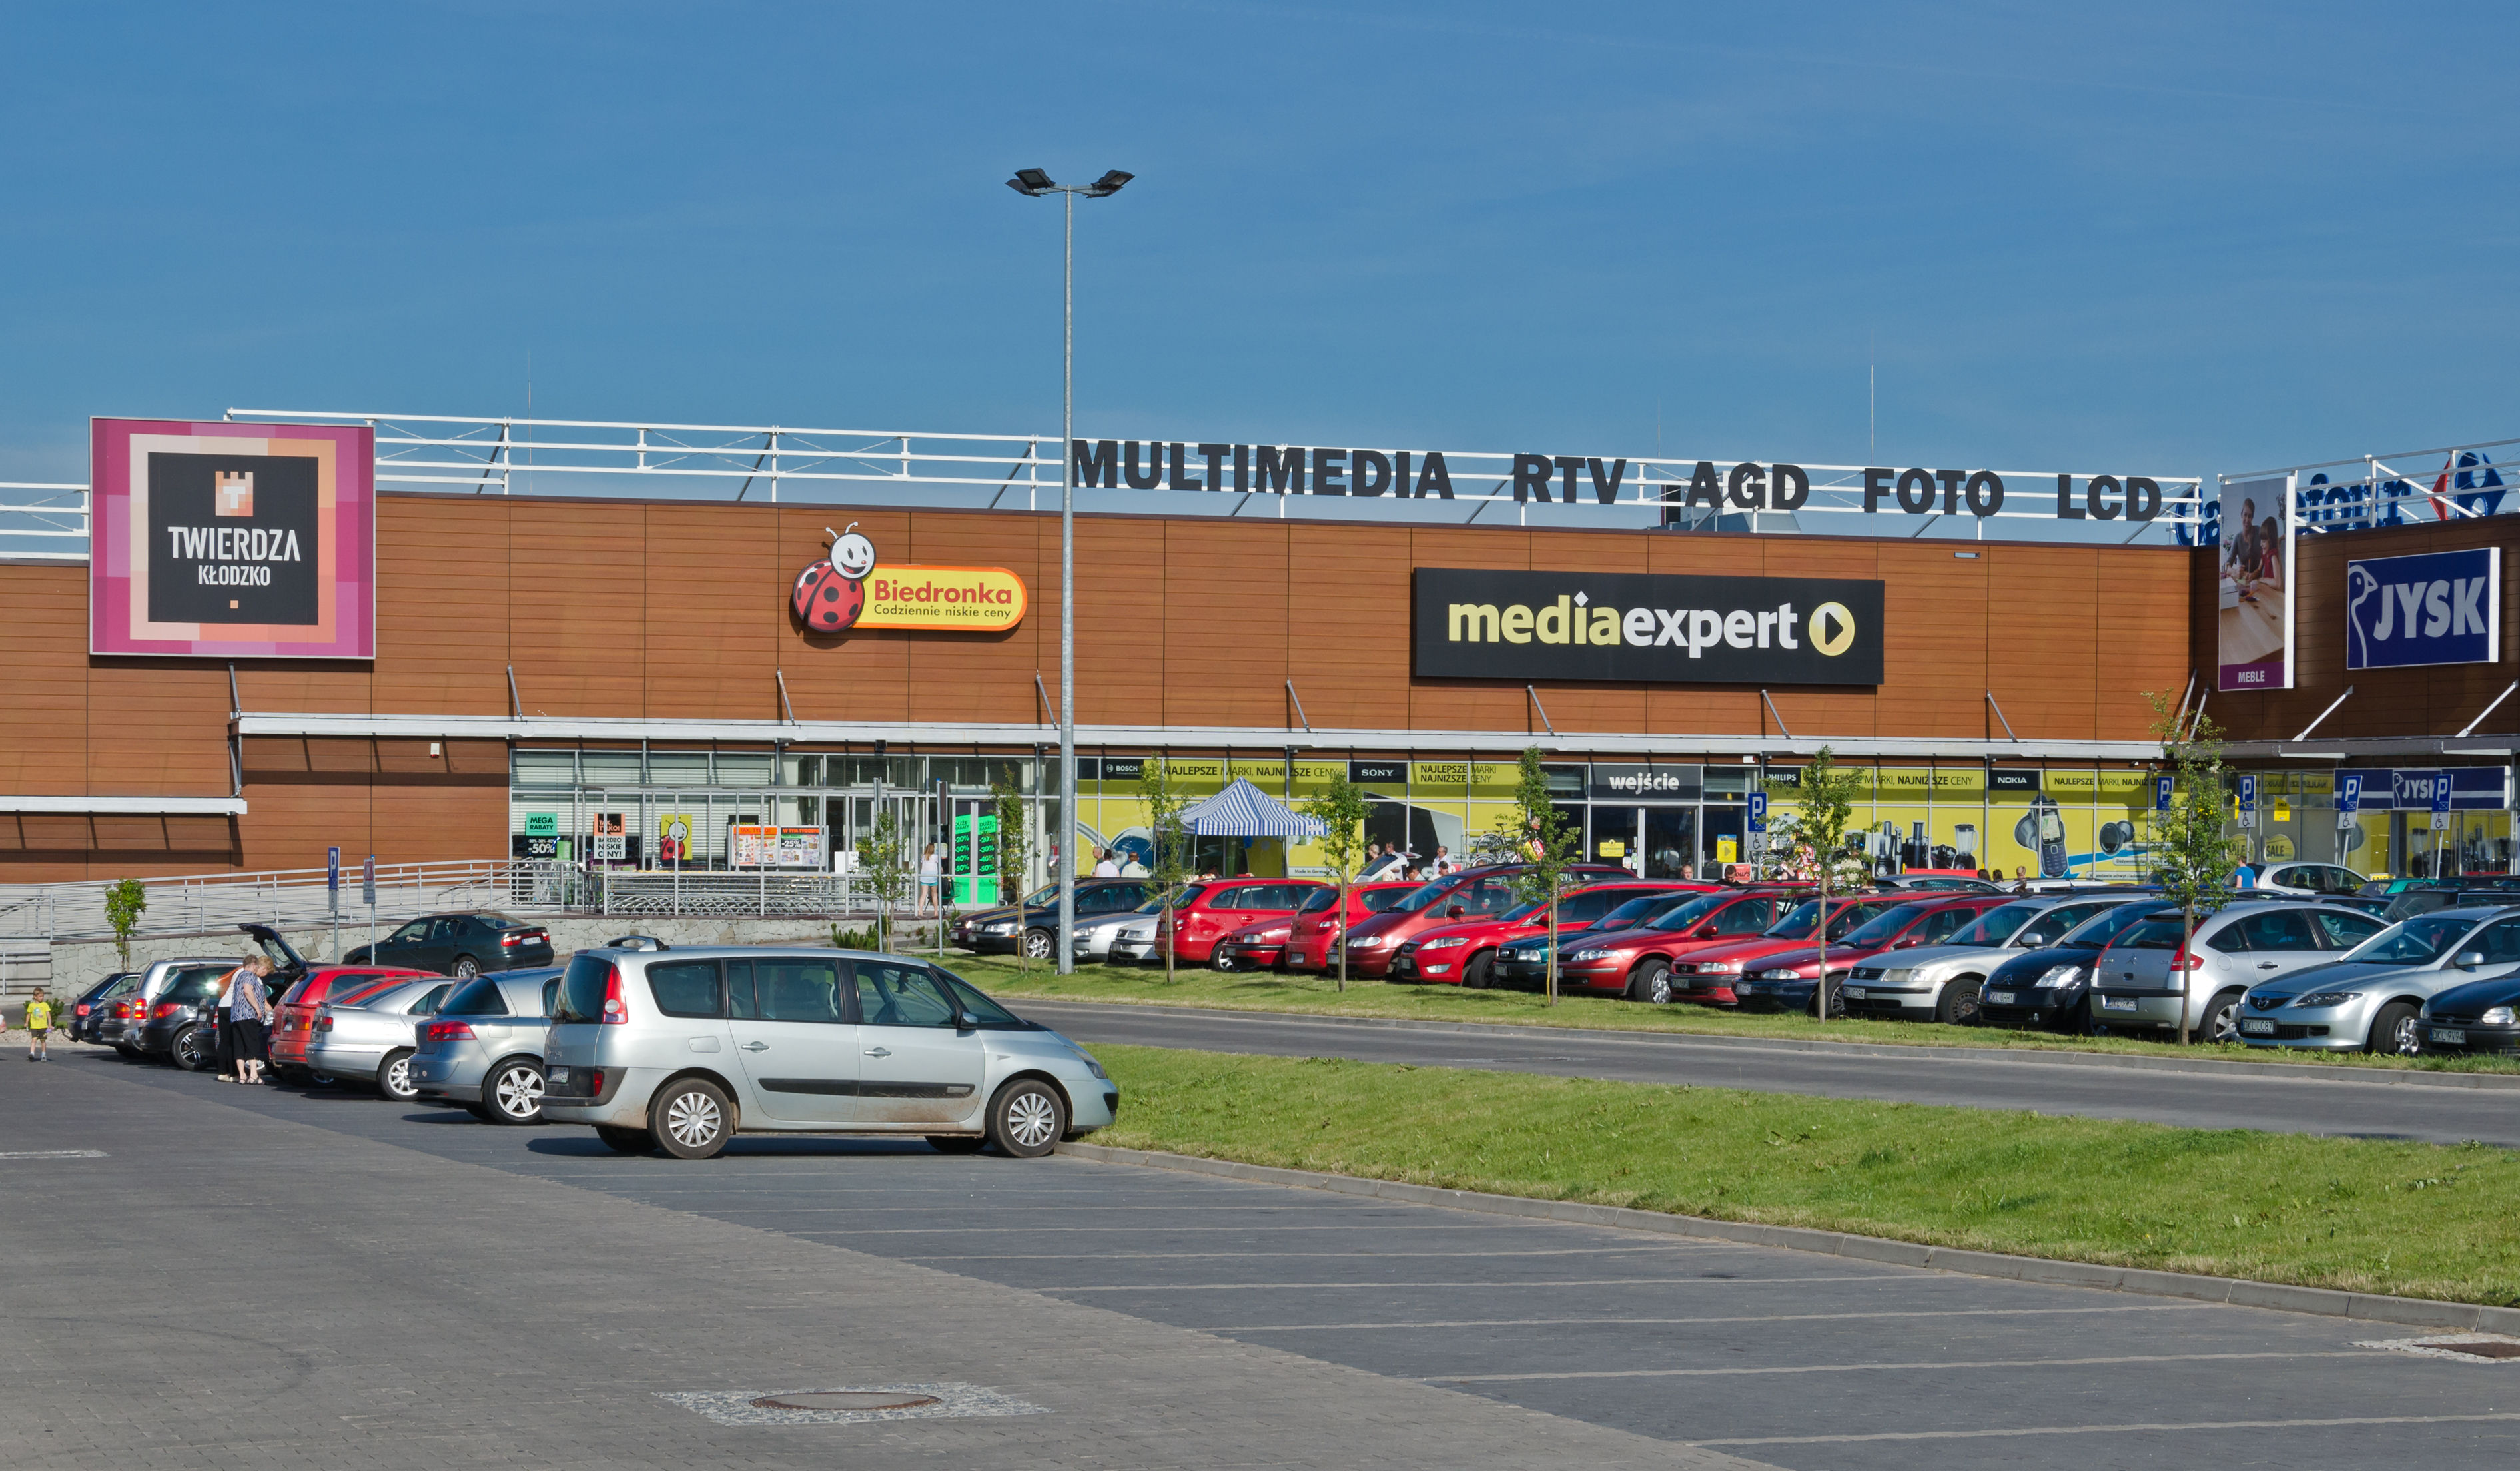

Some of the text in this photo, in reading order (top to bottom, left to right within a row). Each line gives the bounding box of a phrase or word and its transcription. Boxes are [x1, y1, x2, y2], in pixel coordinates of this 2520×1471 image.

[1072, 438, 2162, 521] MULTIMEDIA RTV AGD FOTO LCD
[167, 526, 302, 562] TWIERDZA
[198, 564, 271, 586] KŁODZKO
[875, 579, 1013, 605] Biedronka
[874, 604, 1012, 620] Codziennie niskie ceny
[2373, 576, 2487, 641] JYSK
[1448, 591, 1799, 659] mediaexpert
[2238, 670, 2266, 684] MEBLE
[1164, 766, 1218, 775] NAJLEPSZE
[1420, 765, 1497, 774] NAJLEPSZE MARKI
[1420, 773, 1492, 783] NAJNIŻSZE CENY
[1766, 773, 1797, 782] PHILIPS
[1951, 776, 1974, 785] CENY
[1609, 771, 1679, 795] wejście
[2054, 777, 2094, 786] NAJLEPSZE
[2160, 779, 2170, 801] P
[2243, 779, 2252, 801] P
[2345, 779, 2357, 801] P
[2436, 778, 2448, 801] P
[1752, 795, 1763, 823] P
[528, 843, 556, 854] -50%
[2266, 845, 2285, 857] SALE
[330, 851, 337, 877] P
[2244, 1020, 2273, 1031] DKL LC87
[2433, 1029, 2446, 1041] DKL
